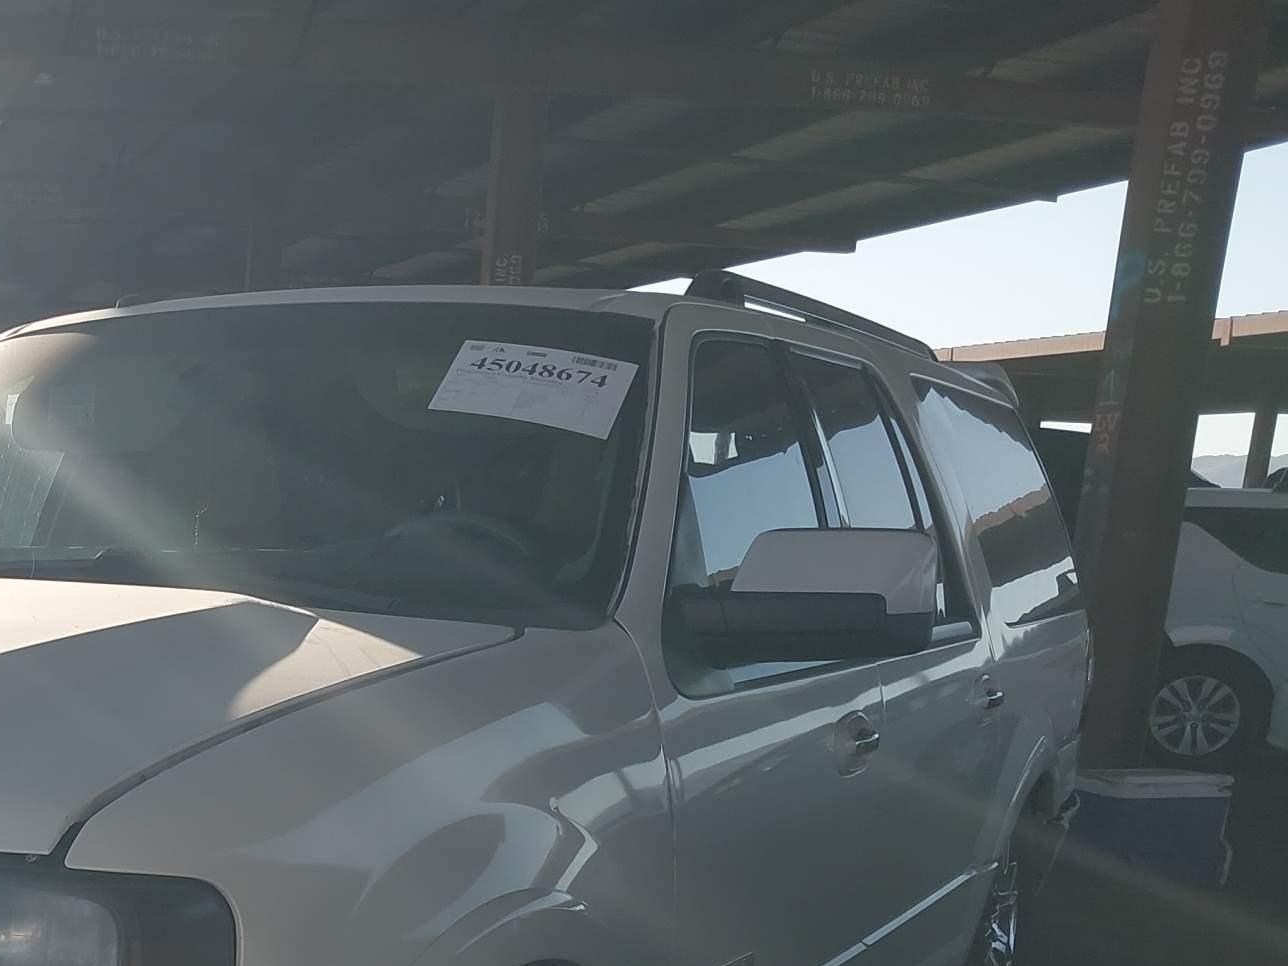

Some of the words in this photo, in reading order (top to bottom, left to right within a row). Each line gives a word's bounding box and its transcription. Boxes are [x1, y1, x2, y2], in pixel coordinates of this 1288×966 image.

[1177, 57, 1201, 103] INC
[1154, 120, 1190, 233] PREFAB
[1168, 51, 1229, 303] 1-866-799-0969
[1143, 252, 1169, 303] U.S.
[470, 356, 608, 388] 45048674
